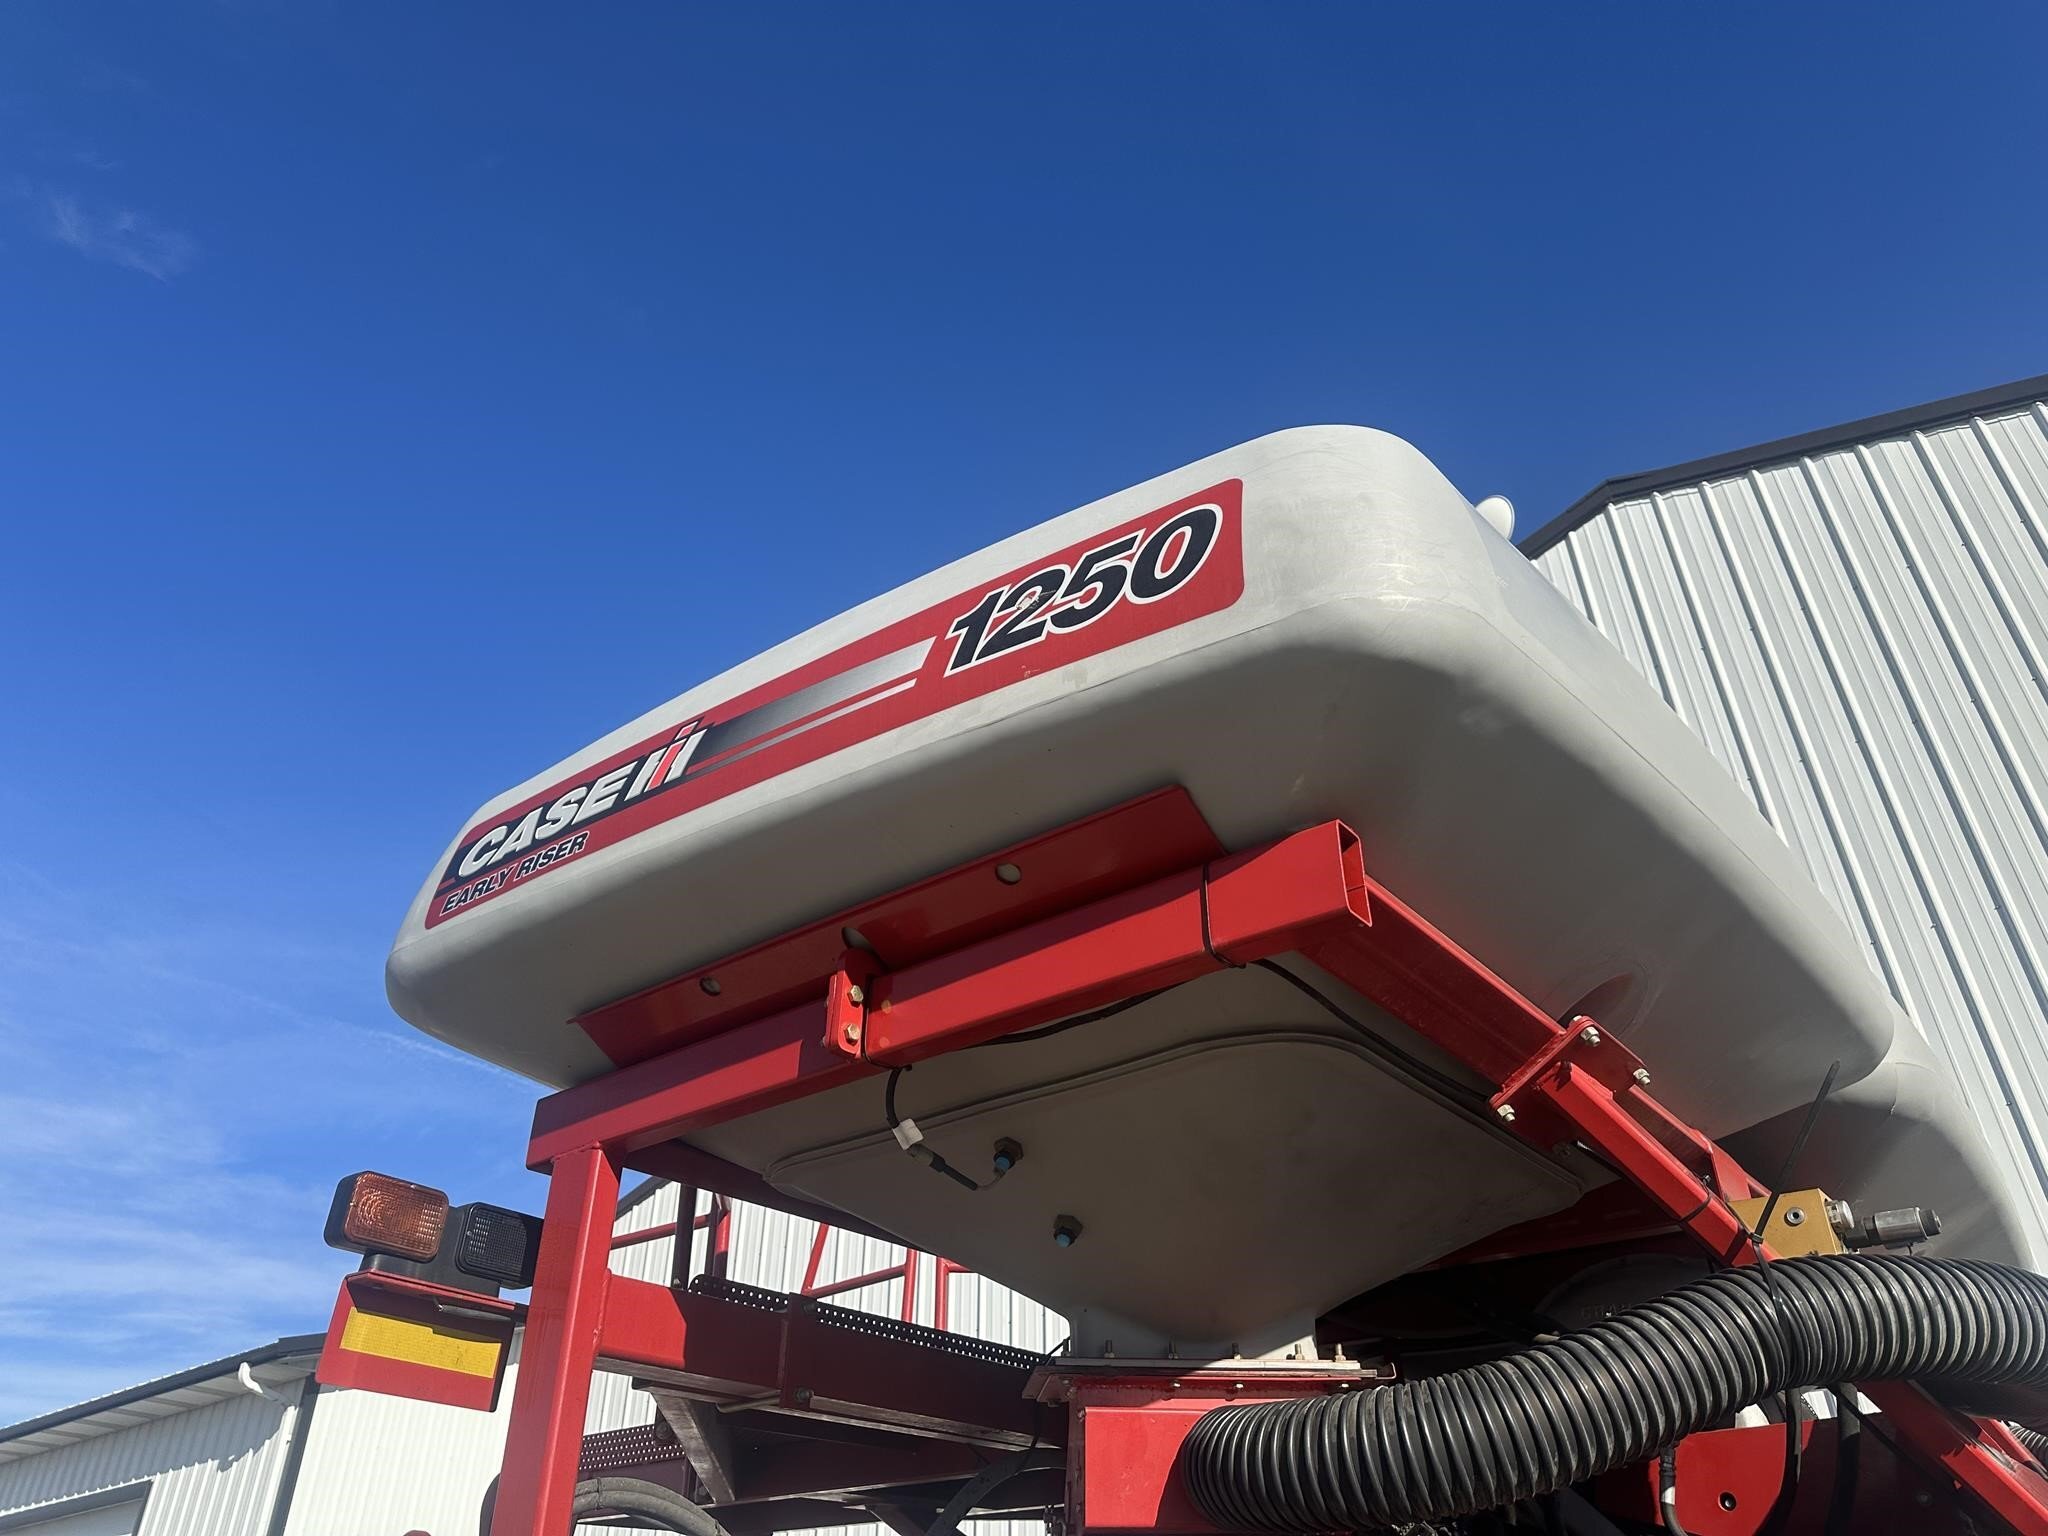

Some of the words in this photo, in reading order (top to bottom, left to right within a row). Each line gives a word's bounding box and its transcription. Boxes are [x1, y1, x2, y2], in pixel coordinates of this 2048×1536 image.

[943, 503, 1223, 678] 1250
[439, 864, 518, 916] EARLY
[513, 831, 590, 881] RISER
